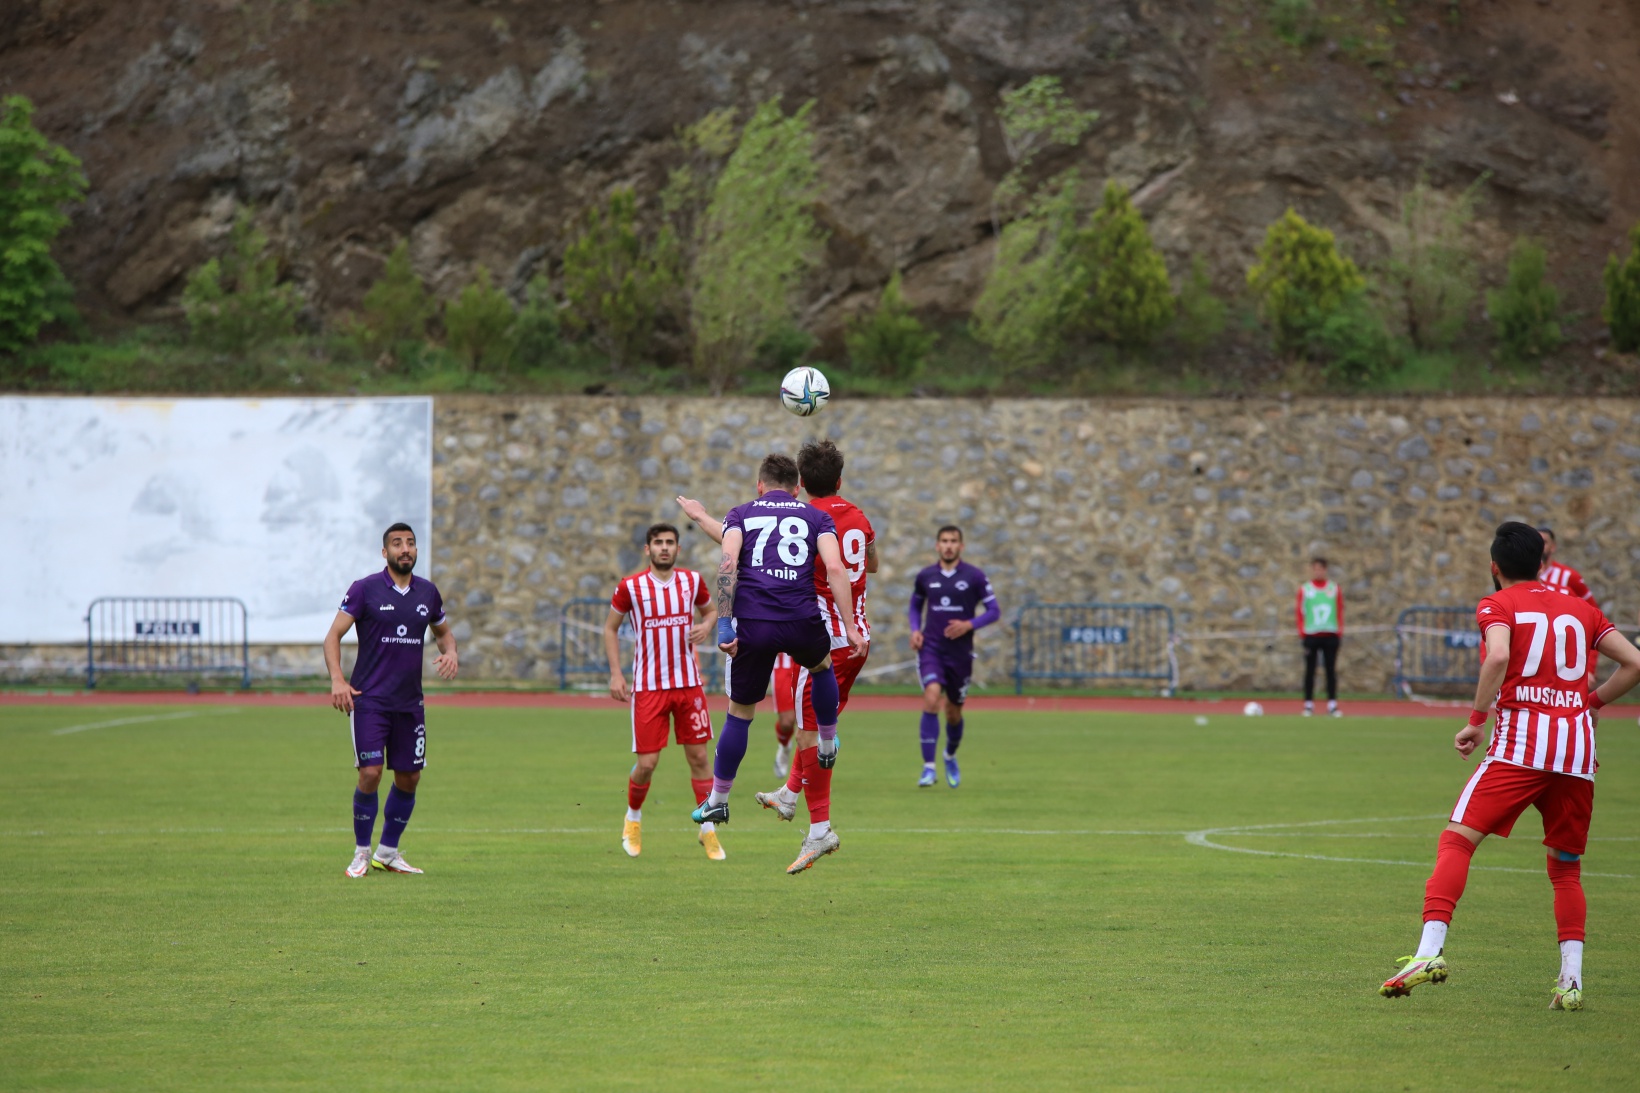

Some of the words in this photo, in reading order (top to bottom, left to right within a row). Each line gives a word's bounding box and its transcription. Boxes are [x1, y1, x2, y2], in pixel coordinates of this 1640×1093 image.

[743, 515, 809, 567] 78
[757, 566, 798, 581] ADİR
[381, 636, 421, 645] CRIPTOSWAPS
[1514, 611, 1587, 682] 70
[1515, 685, 1583, 708] MUSTAFA
[690, 709, 708, 731] 30
[415, 736, 426, 757] 8
